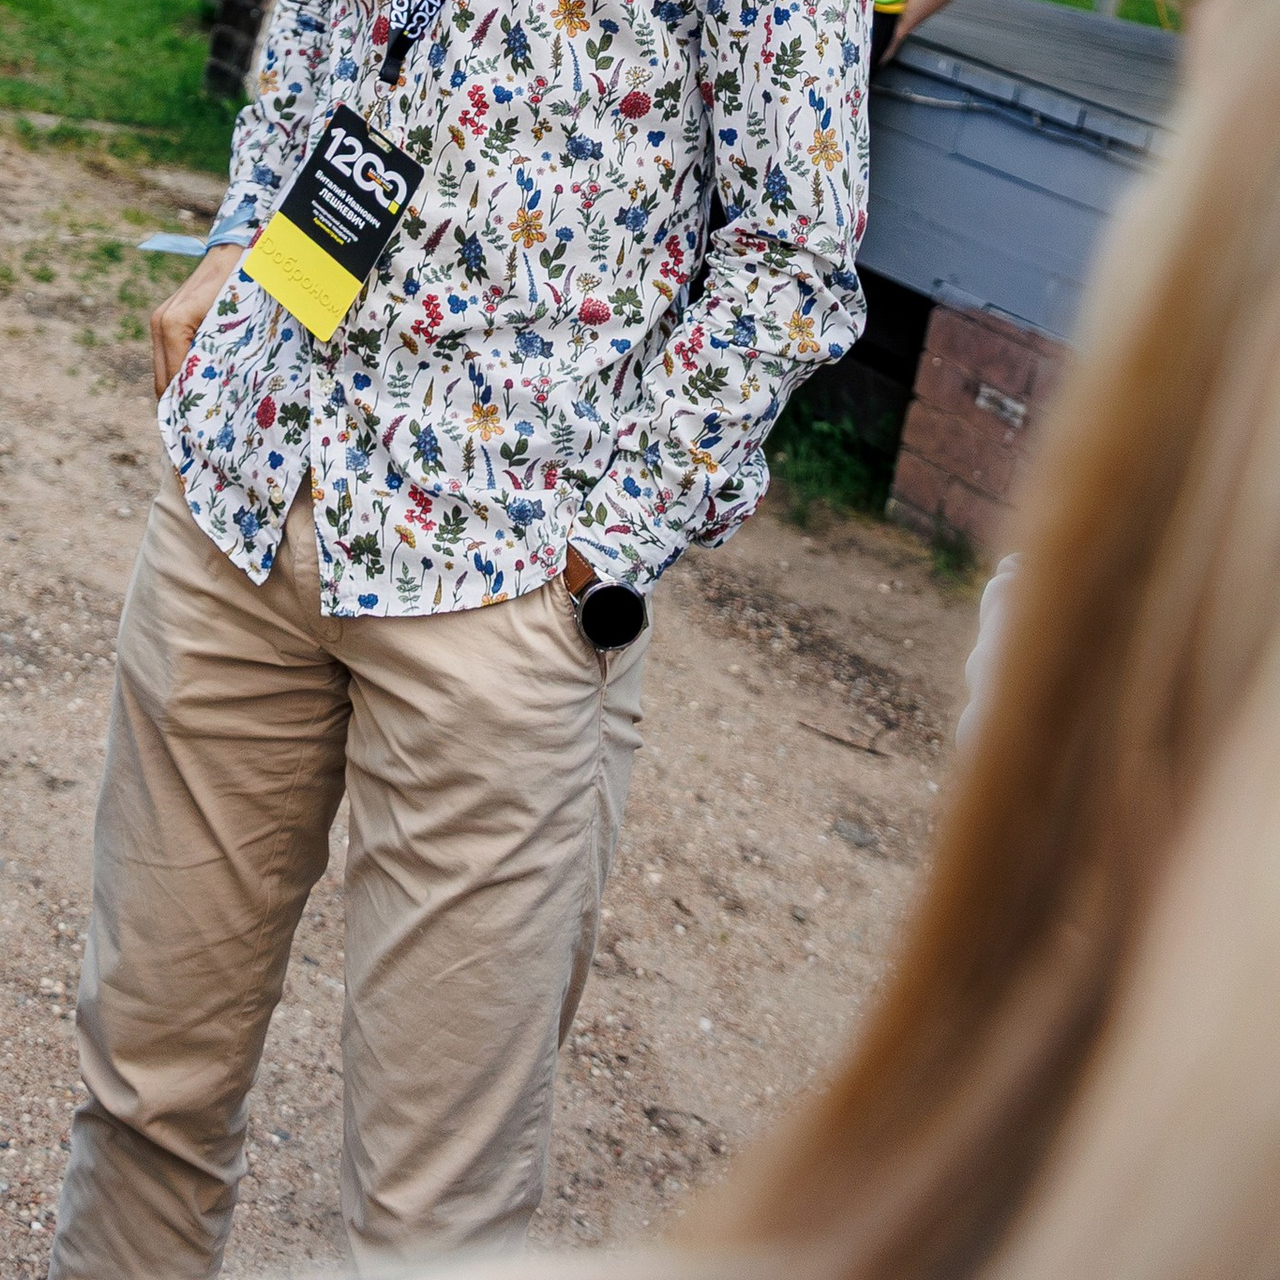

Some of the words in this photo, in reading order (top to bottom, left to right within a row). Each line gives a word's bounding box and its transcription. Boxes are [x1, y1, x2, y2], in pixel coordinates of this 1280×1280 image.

[315, 169, 347, 199] Виталий
[345, 194, 381, 229] Иванович
[324, 127, 408, 215] 1200
[318, 188, 366, 230] ЛЕШКЕВИЧ
[258, 237, 344, 318] Доброном
